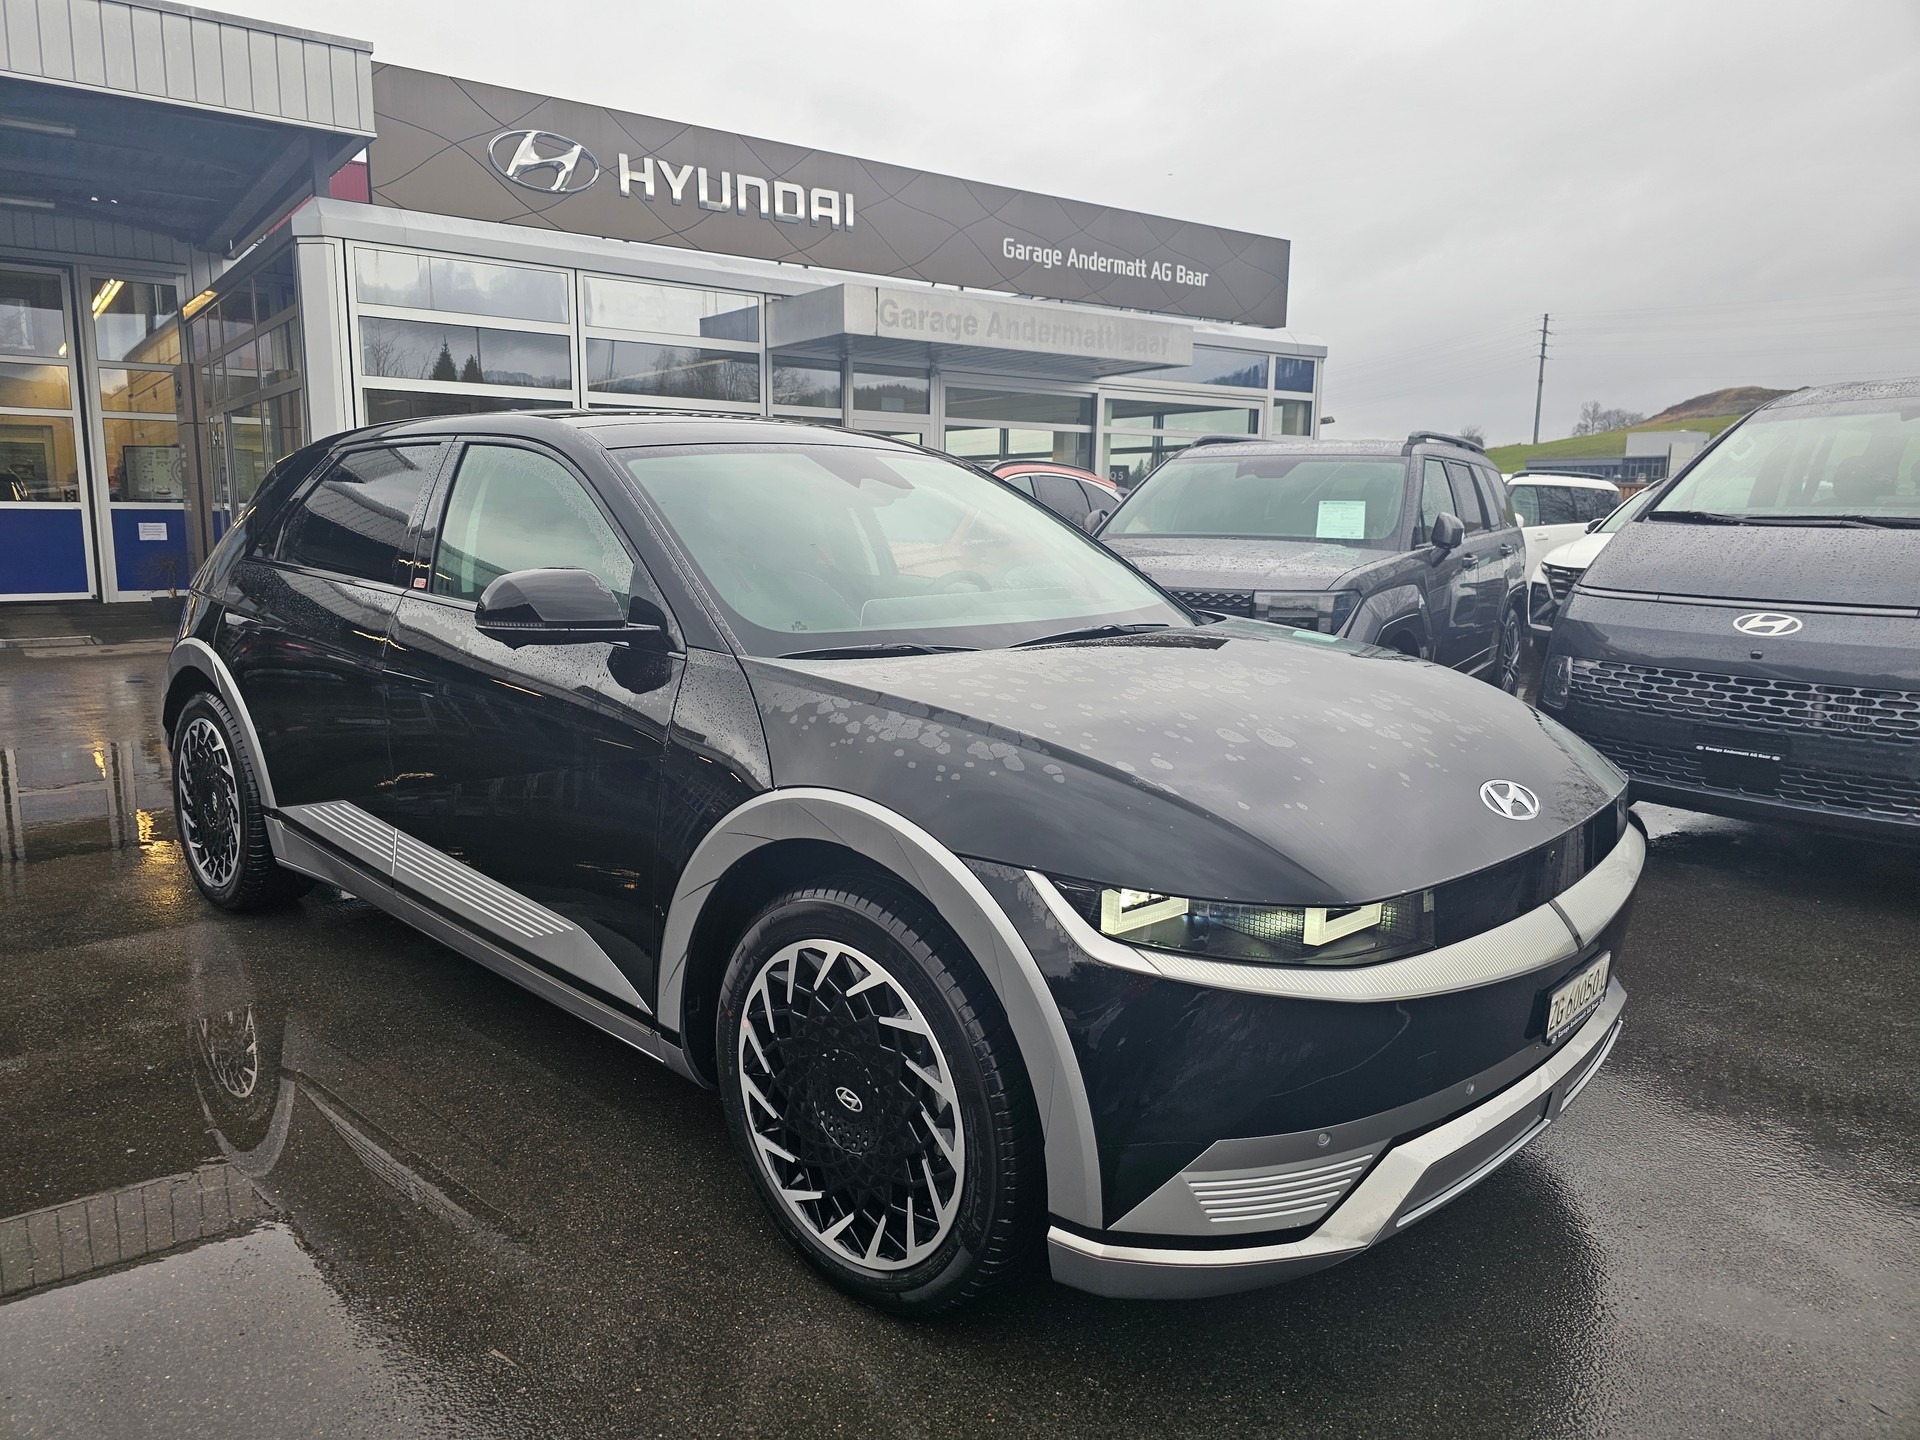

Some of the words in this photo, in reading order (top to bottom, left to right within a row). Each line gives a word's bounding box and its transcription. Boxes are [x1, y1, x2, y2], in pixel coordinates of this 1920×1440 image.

[618, 153, 854, 231] HYUNDAI
[1003, 237, 1062, 268] Garage
[1067, 248, 1147, 278] Andermatt
[1151, 262, 1172, 281] AG
[1176, 265, 1209, 287] Baar
[878, 298, 979, 341] Garage
[986, 312, 1112, 350] Andermatt
[1121, 327, 1170, 356] Baar
